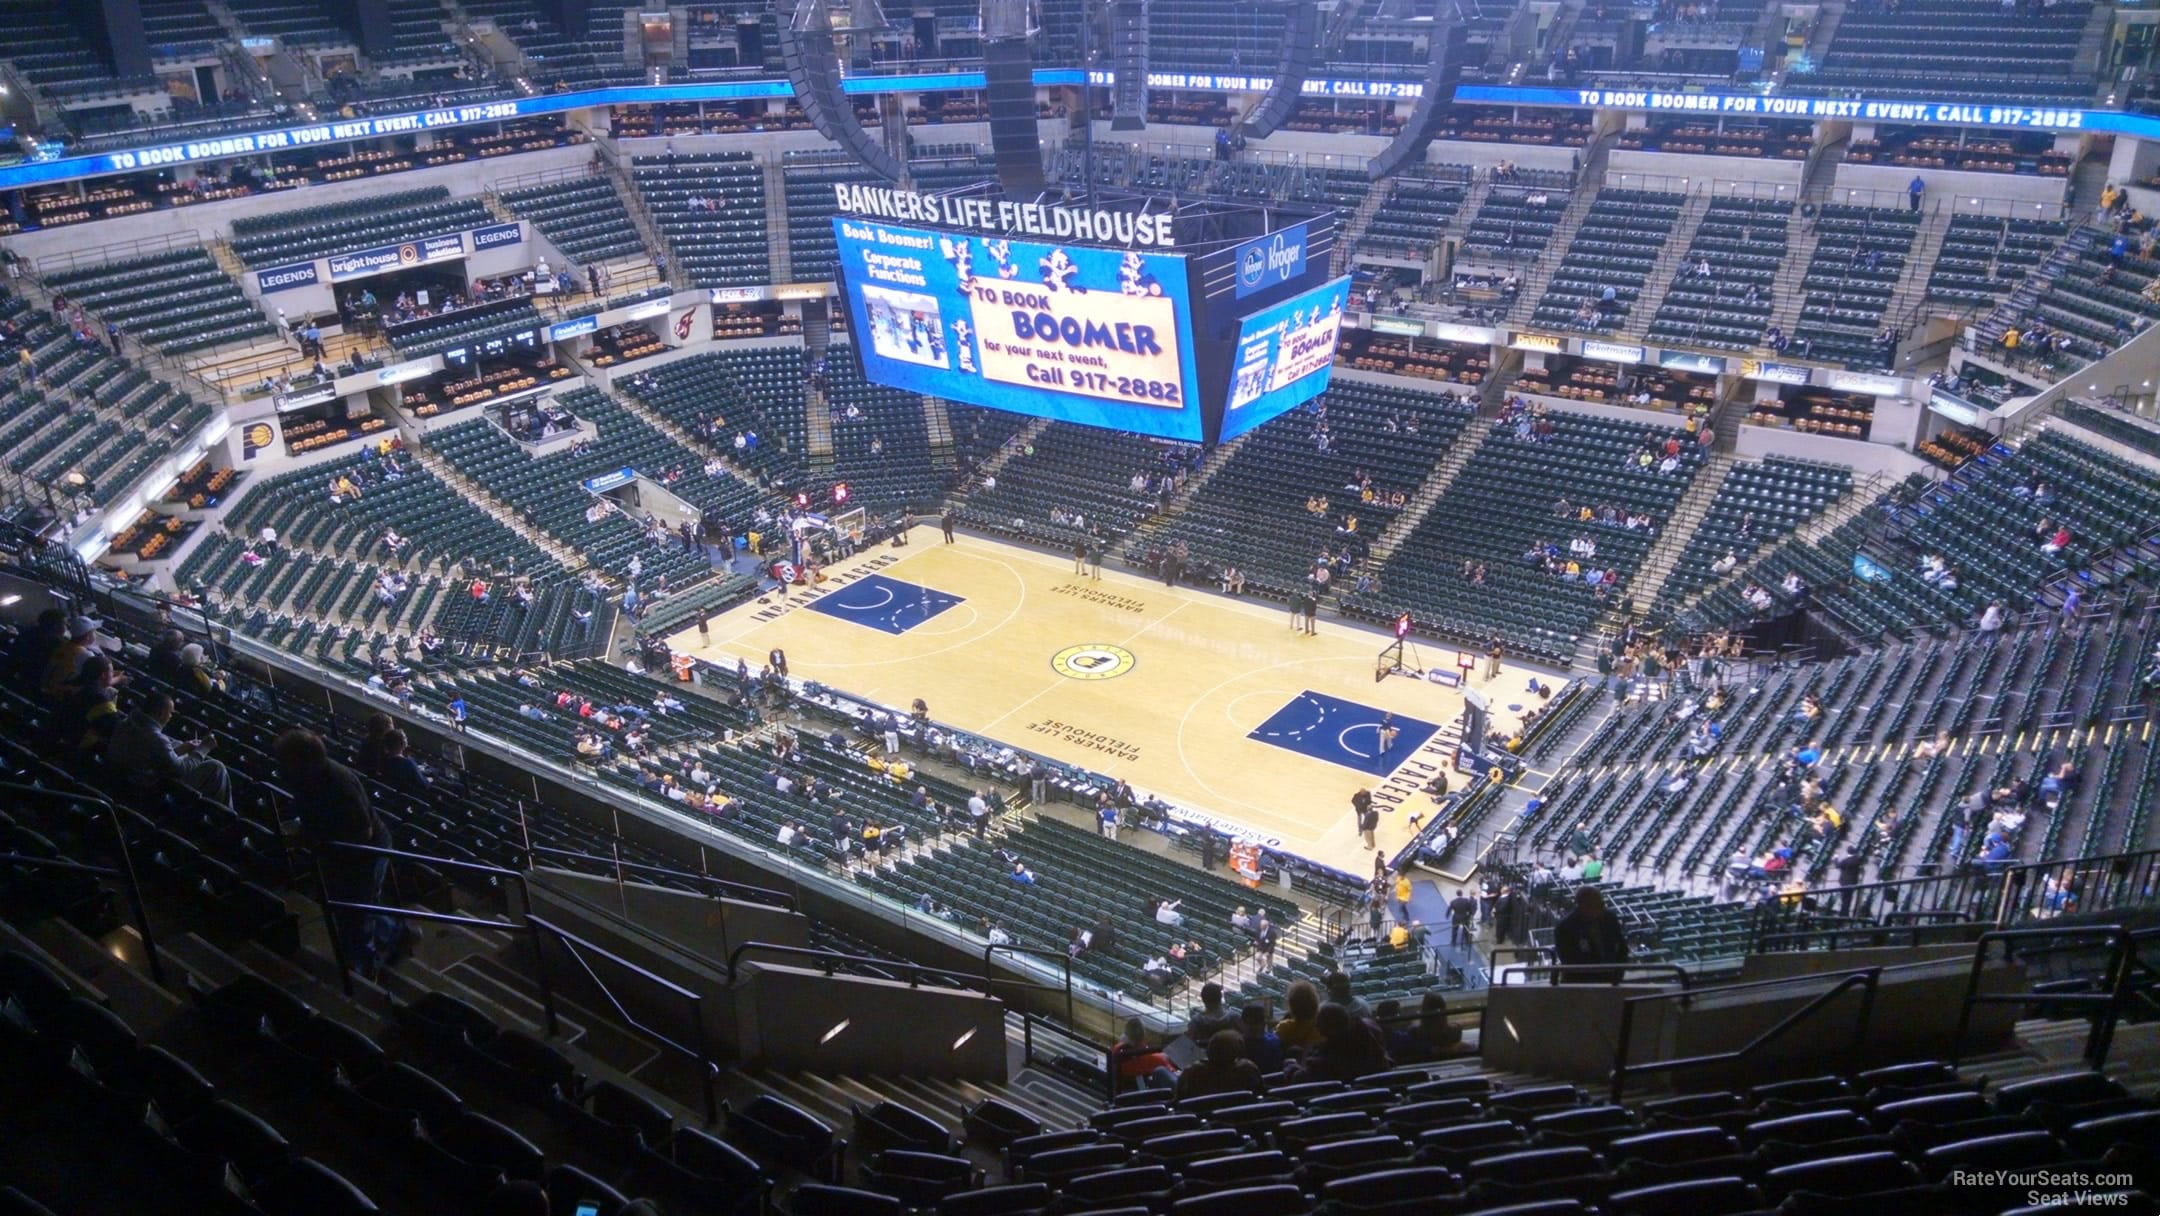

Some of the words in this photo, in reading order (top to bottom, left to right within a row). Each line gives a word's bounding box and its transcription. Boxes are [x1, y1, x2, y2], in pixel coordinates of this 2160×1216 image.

[1089, 71, 1104, 84] TO
[1189, 75, 1213, 89] FOR
[1215, 76, 1248, 90] YOUR
[1250, 77, 1274, 91] NEX
[1302, 79, 1330, 94] ENT,
[1333, 80, 1366, 95] CALL
[1369, 82, 1424, 97] 917-288
[1579, 91, 1600, 105] TO
[1603, 92, 1647, 107] BOOK
[1651, 93, 1718, 110] BOOMER
[1723, 96, 1757, 111] FOR
[1762, 98, 1809, 115] YOUR
[1813, 100, 1861, 117] NEXT
[1866, 103, 1930, 122] EVENT,
[1936, 105, 1984, 123] CALL
[1989, 108, 2082, 128] 917-2882
[111, 154, 136, 170] TO
[138, 146, 185, 166] BOOK
[188, 137, 255, 159] BOOMER
[257, 132, 289, 149] FOR
[290, 126, 331, 144] YOUR
[334, 121, 371, 139] NEXT
[375, 115, 424, 134] EVENT,
[425, 110, 458, 127] CALL
[461, 102, 518, 122] 917-2882
[834, 182, 940, 224] BANKERS
[943, 196, 996, 230] LIFE
[998, 200, 1176, 247] FIELDHOUSE
[425, 236, 459, 250] business
[475, 228, 520, 246] LEGENDS
[842, 222, 876, 241] Book
[877, 228, 935, 250] Boomer!
[332, 256, 364, 274] bright
[365, 251, 399, 269] house
[427, 245, 462, 259] solutions
[862, 248, 923, 271] Corporate
[1268, 234, 1300, 280] Kroger
[260, 268, 315, 289] LEGENDS
[867, 263, 927, 287] Functions
[974, 285, 997, 304] TO
[1002, 290, 1051, 311] BOOK
[1010, 310, 1164, 357] BOOMER
[1291, 328, 1333, 361] BOOMER
[984, 337, 1000, 352] for
[1004, 344, 1032, 357] your
[1036, 348, 1064, 361] next
[1068, 353, 1109, 369] event,
[1586, 342, 1642, 359] ticketmaster
[1026, 363, 1065, 385] Call
[1070, 370, 1181, 402] 917-2882
[750, 587, 832, 622] INDIANA
[830, 554, 900, 585] PACERS
[1050, 586, 1079, 597] LIFE
[1063, 583, 1145, 607] FIELDHOUSE
[1080, 594, 1144, 613] BANKERS
[1026, 722, 1061, 737] LIFE
[1042, 719, 1141, 753] FIELDHOUSE
[1063, 733, 1139, 762] BANKERS
[1371, 760, 1438, 813] PACERS
